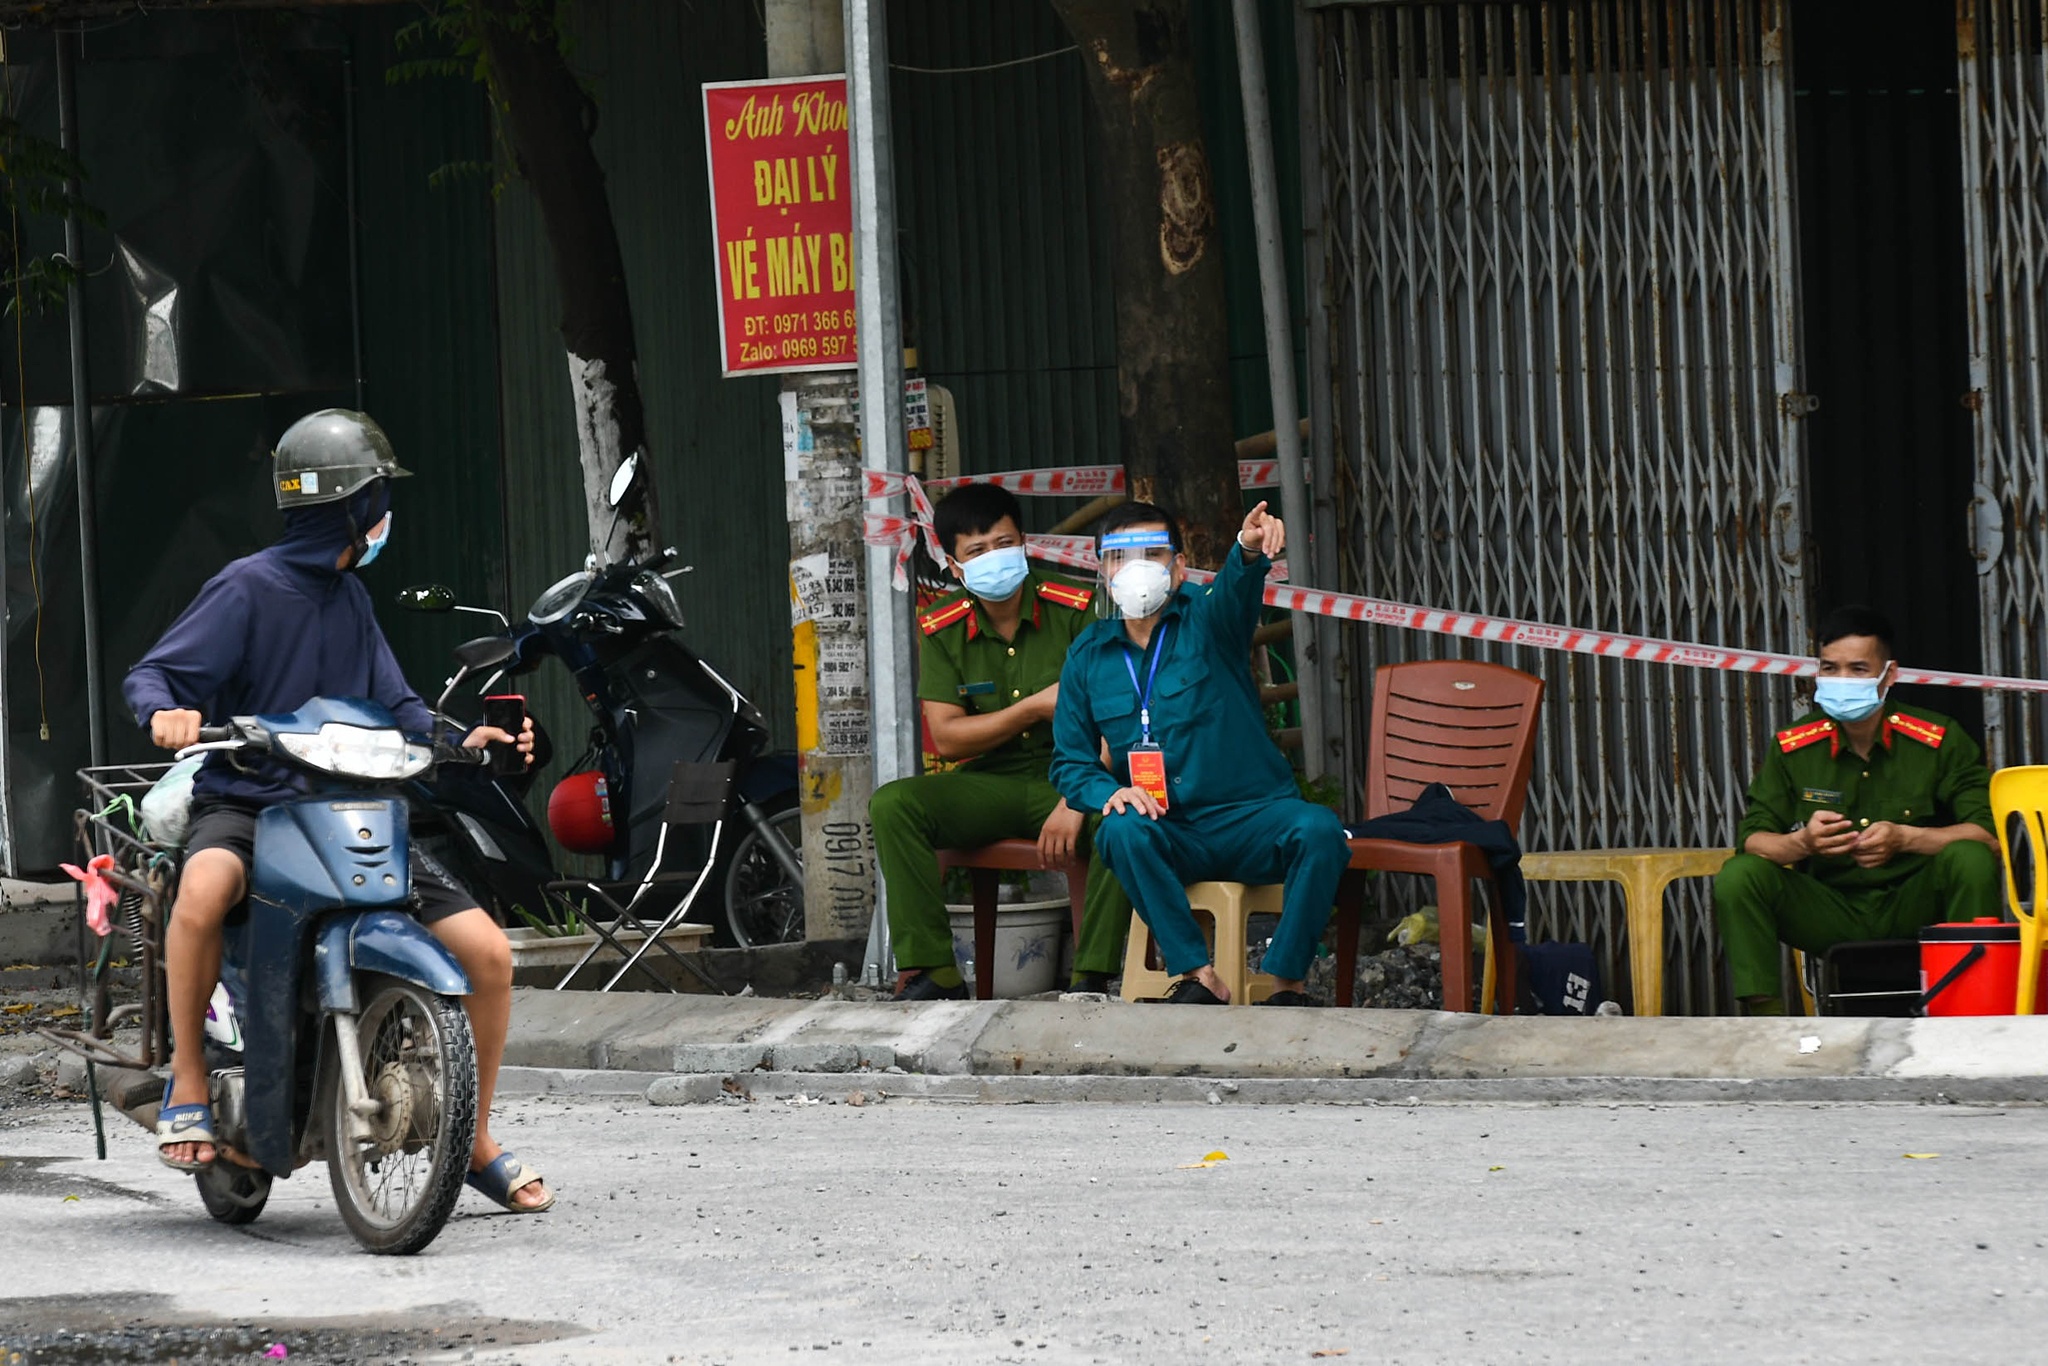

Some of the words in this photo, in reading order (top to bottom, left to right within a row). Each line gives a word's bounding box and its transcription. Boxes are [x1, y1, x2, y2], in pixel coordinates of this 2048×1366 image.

[725, 94, 784, 140] Anh
[754, 157, 800, 215] ĐẠI
[807, 145, 837, 202] LÝ
[726, 226, 760, 300] VÉ
[765, 222, 821, 297] MÁY
[744, 316, 769, 337] ĐT:
[773, 313, 808, 334] 0971
[812, 310, 840, 331] 366
[740, 341, 777, 363] Zalo:
[782, 337, 817, 359] 0969
[822, 335, 847, 356] 597
